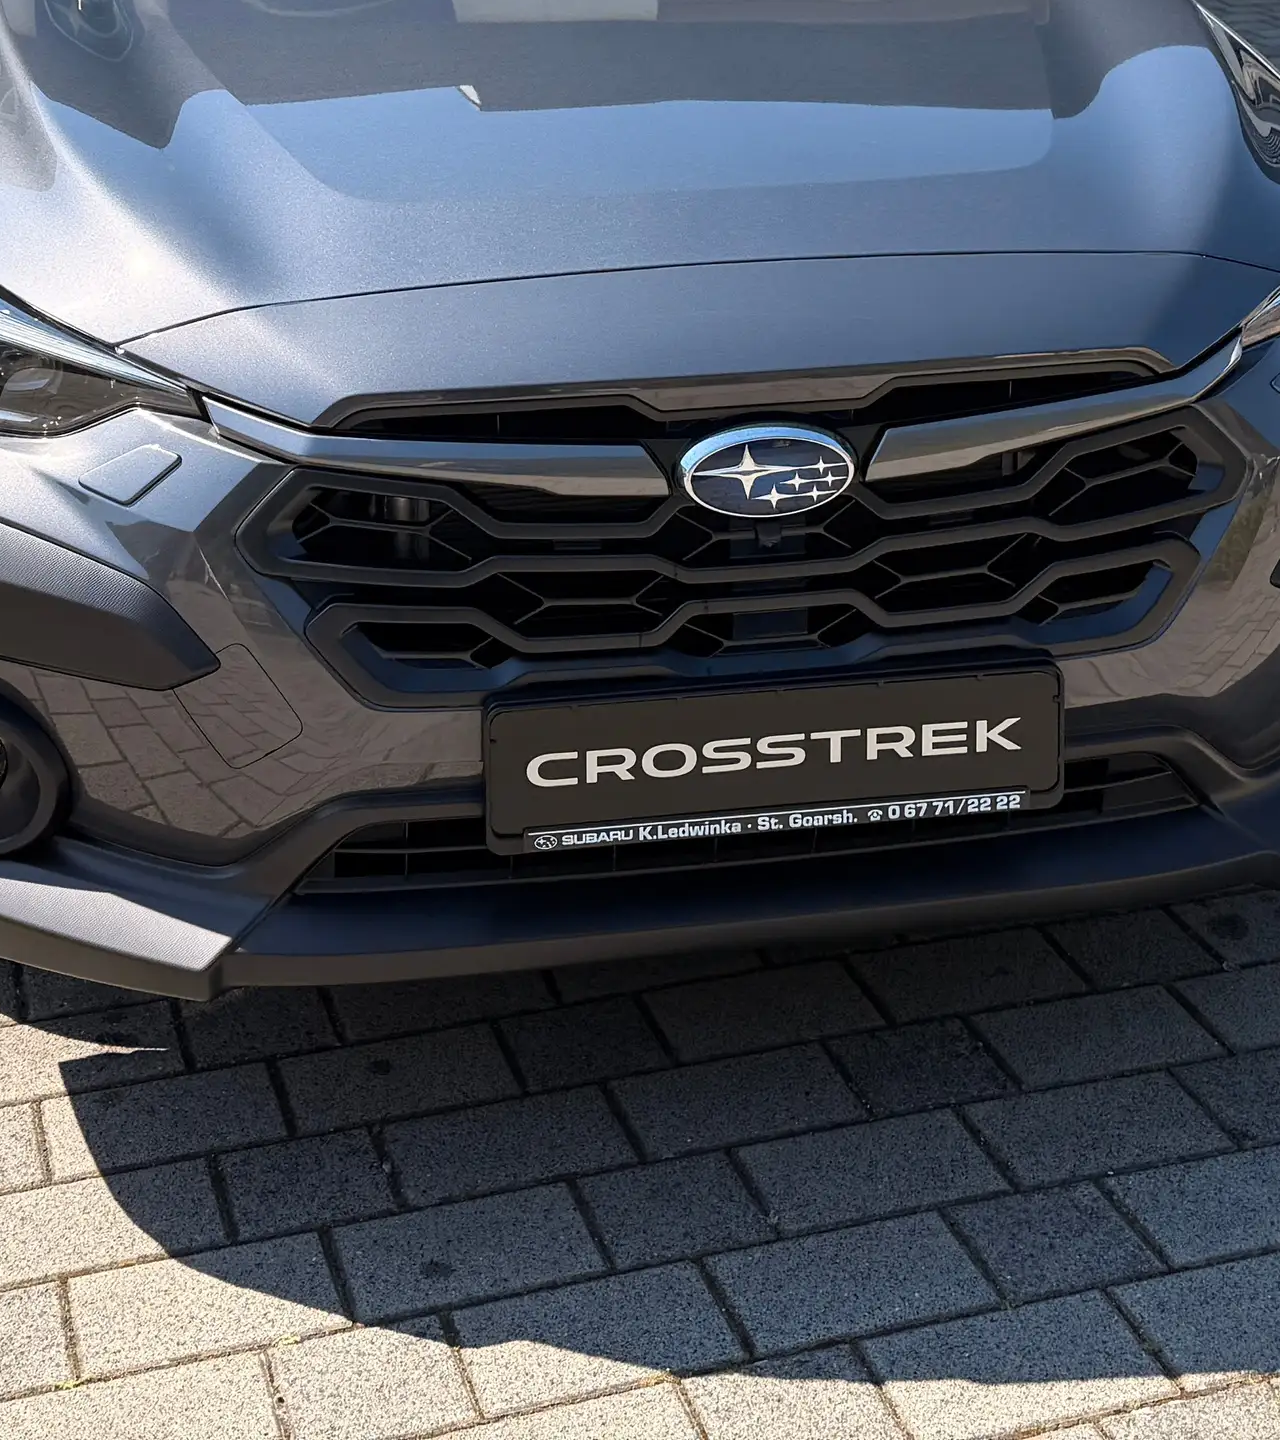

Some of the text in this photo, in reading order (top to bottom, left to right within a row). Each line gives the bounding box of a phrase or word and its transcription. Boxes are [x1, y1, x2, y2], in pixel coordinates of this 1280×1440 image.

[526, 716, 1022, 788] CROSSTREK
[561, 828, 634, 846] SUBARU
[757, 816, 784, 831] St.
[788, 809, 858, 828] Goarsh.
